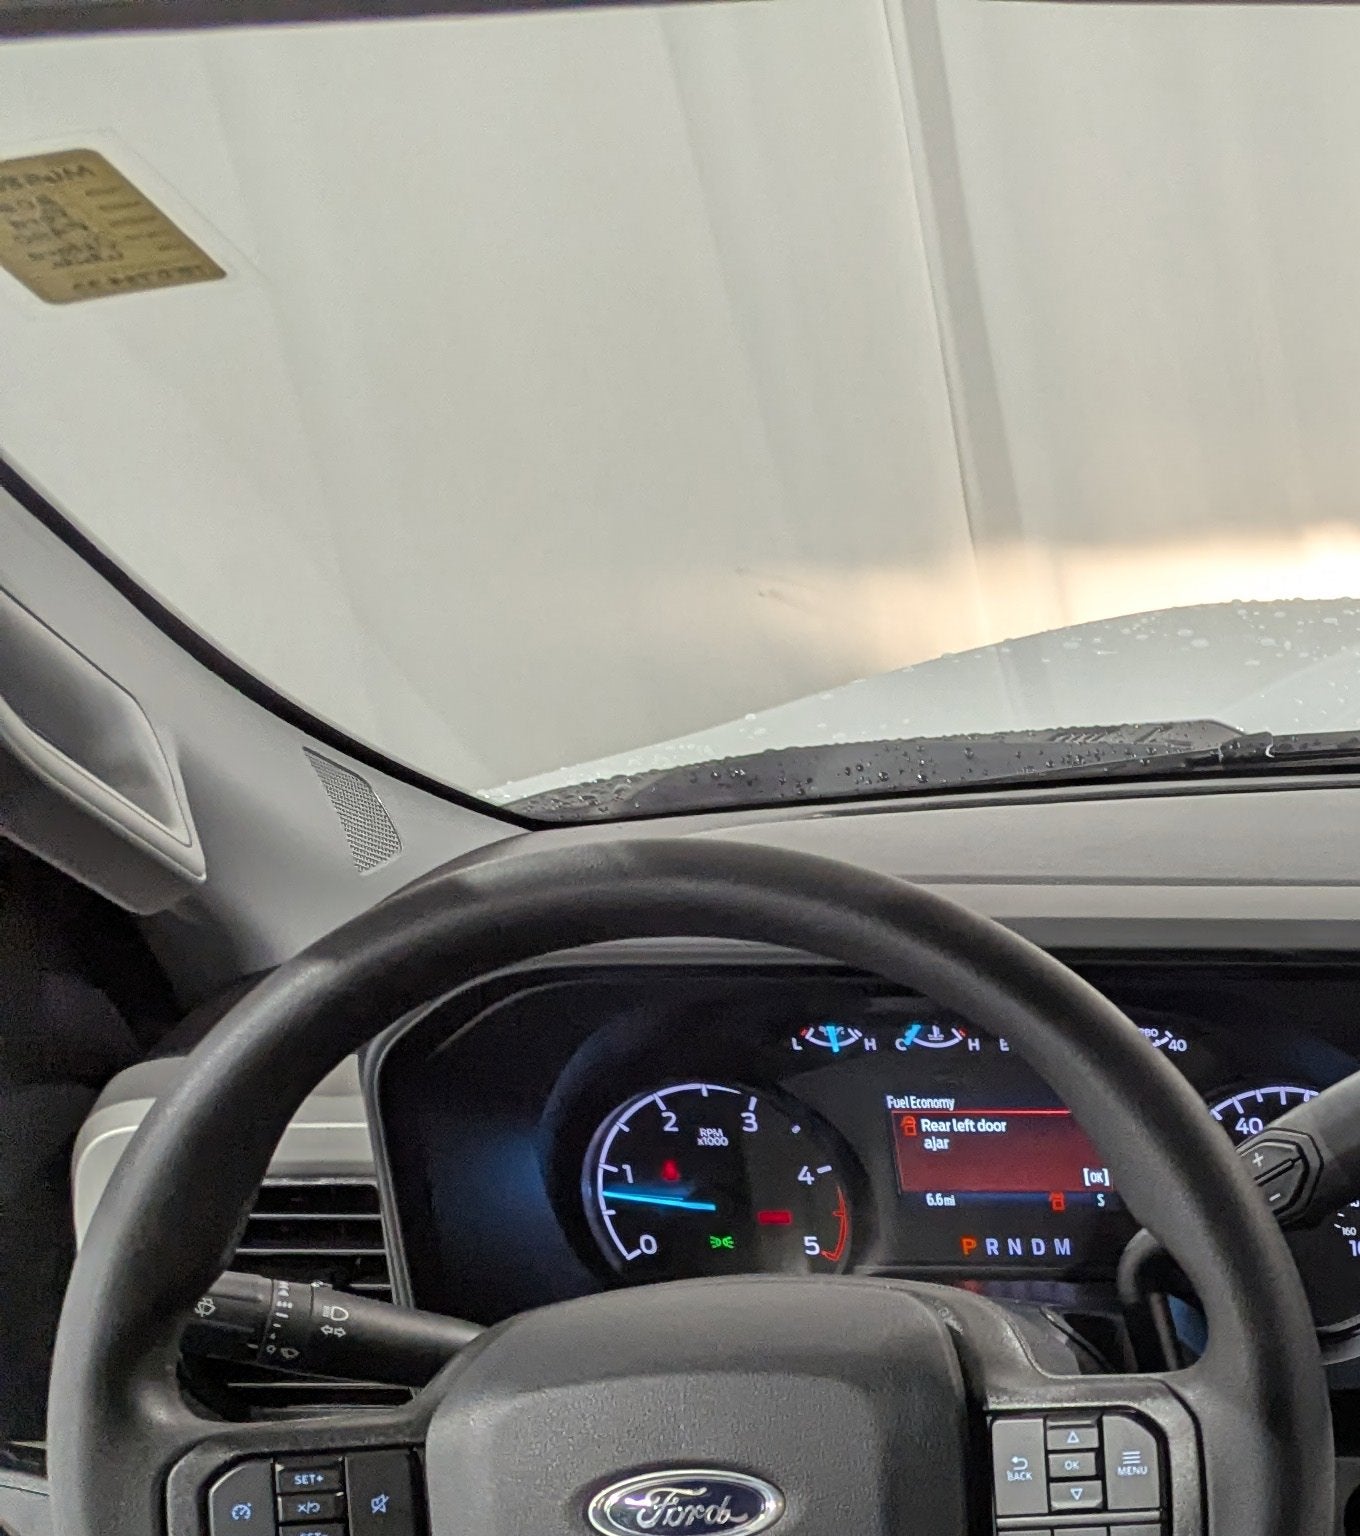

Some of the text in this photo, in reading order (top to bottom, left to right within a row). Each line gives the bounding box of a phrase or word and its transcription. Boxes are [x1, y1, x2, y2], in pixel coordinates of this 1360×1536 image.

[792, 1038, 803, 1051] L
[864, 1038, 876, 1051] H
[968, 1038, 980, 1051] H
[1168, 1039, 1187, 1052] 40
[886, 1095, 955, 1111] Fuel Economy
[661, 1112, 679, 1132] 2
[741, 1112, 758, 1133] 3
[920, 1118, 1007, 1132] Rear left door
[1234, 1117, 1263, 1134] 40
[699, 1127, 724, 1138] RPM
[923, 1136, 950, 1151] ajar
[621, 1164, 633, 1183] 1
[797, 1165, 815, 1185] 4
[639, 1234, 658, 1255] 0
[803, 1236, 820, 1255] 5
[961, 1237, 1071, 1256] P R N D M
[1064, 1461, 1080, 1470] OK
[1117, 1466, 1148, 1476] MENU
[294, 1474, 324, 1485] SET+
[1006, 1471, 1032, 1481] BACK
[624, 1487, 748, 1529] Ford
